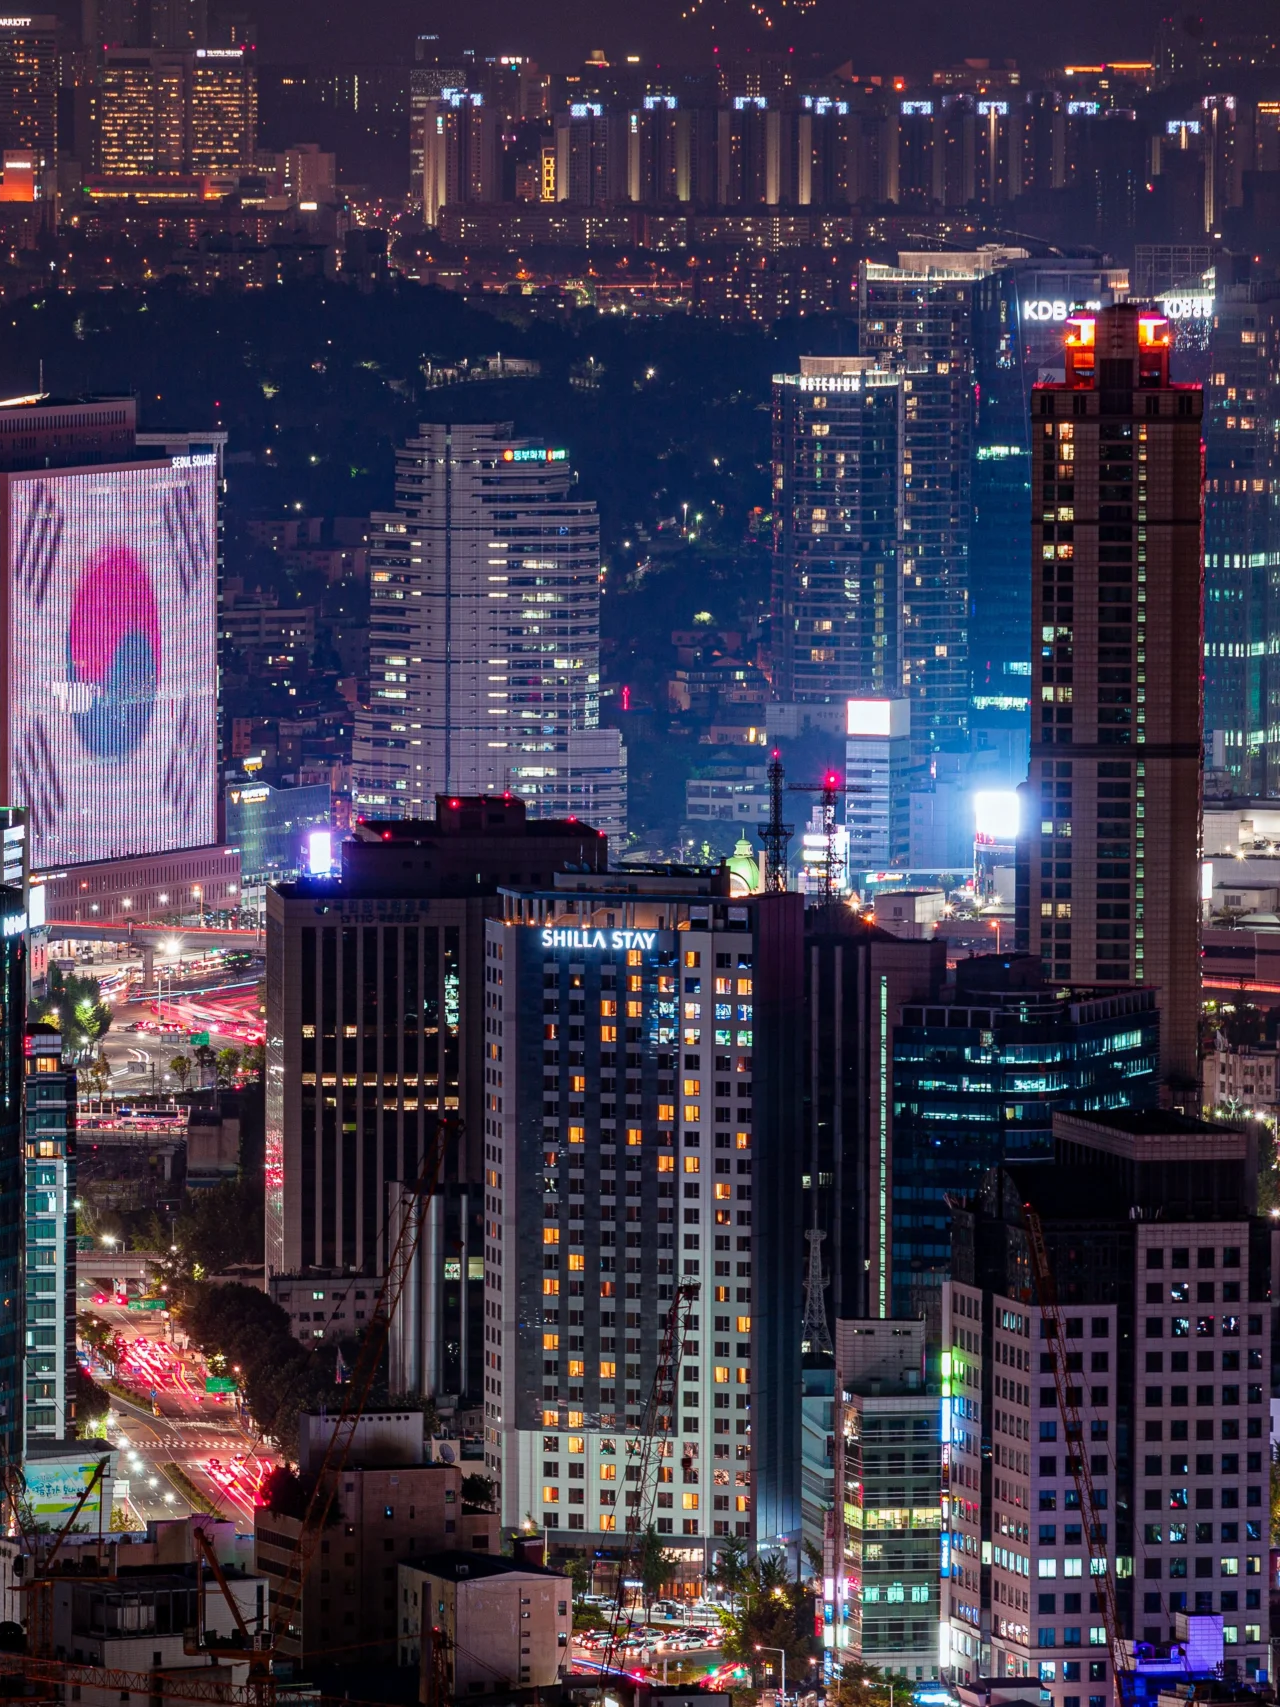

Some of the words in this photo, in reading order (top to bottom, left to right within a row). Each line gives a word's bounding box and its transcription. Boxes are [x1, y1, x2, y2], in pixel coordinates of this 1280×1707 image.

[172, 455, 191, 469] SEOUL
[192, 453, 217, 467] SQUARE
[513, 449, 547, 461] 동부화재
[541, 929, 606, 949] SHILLA
[612, 931, 656, 949] STAY
